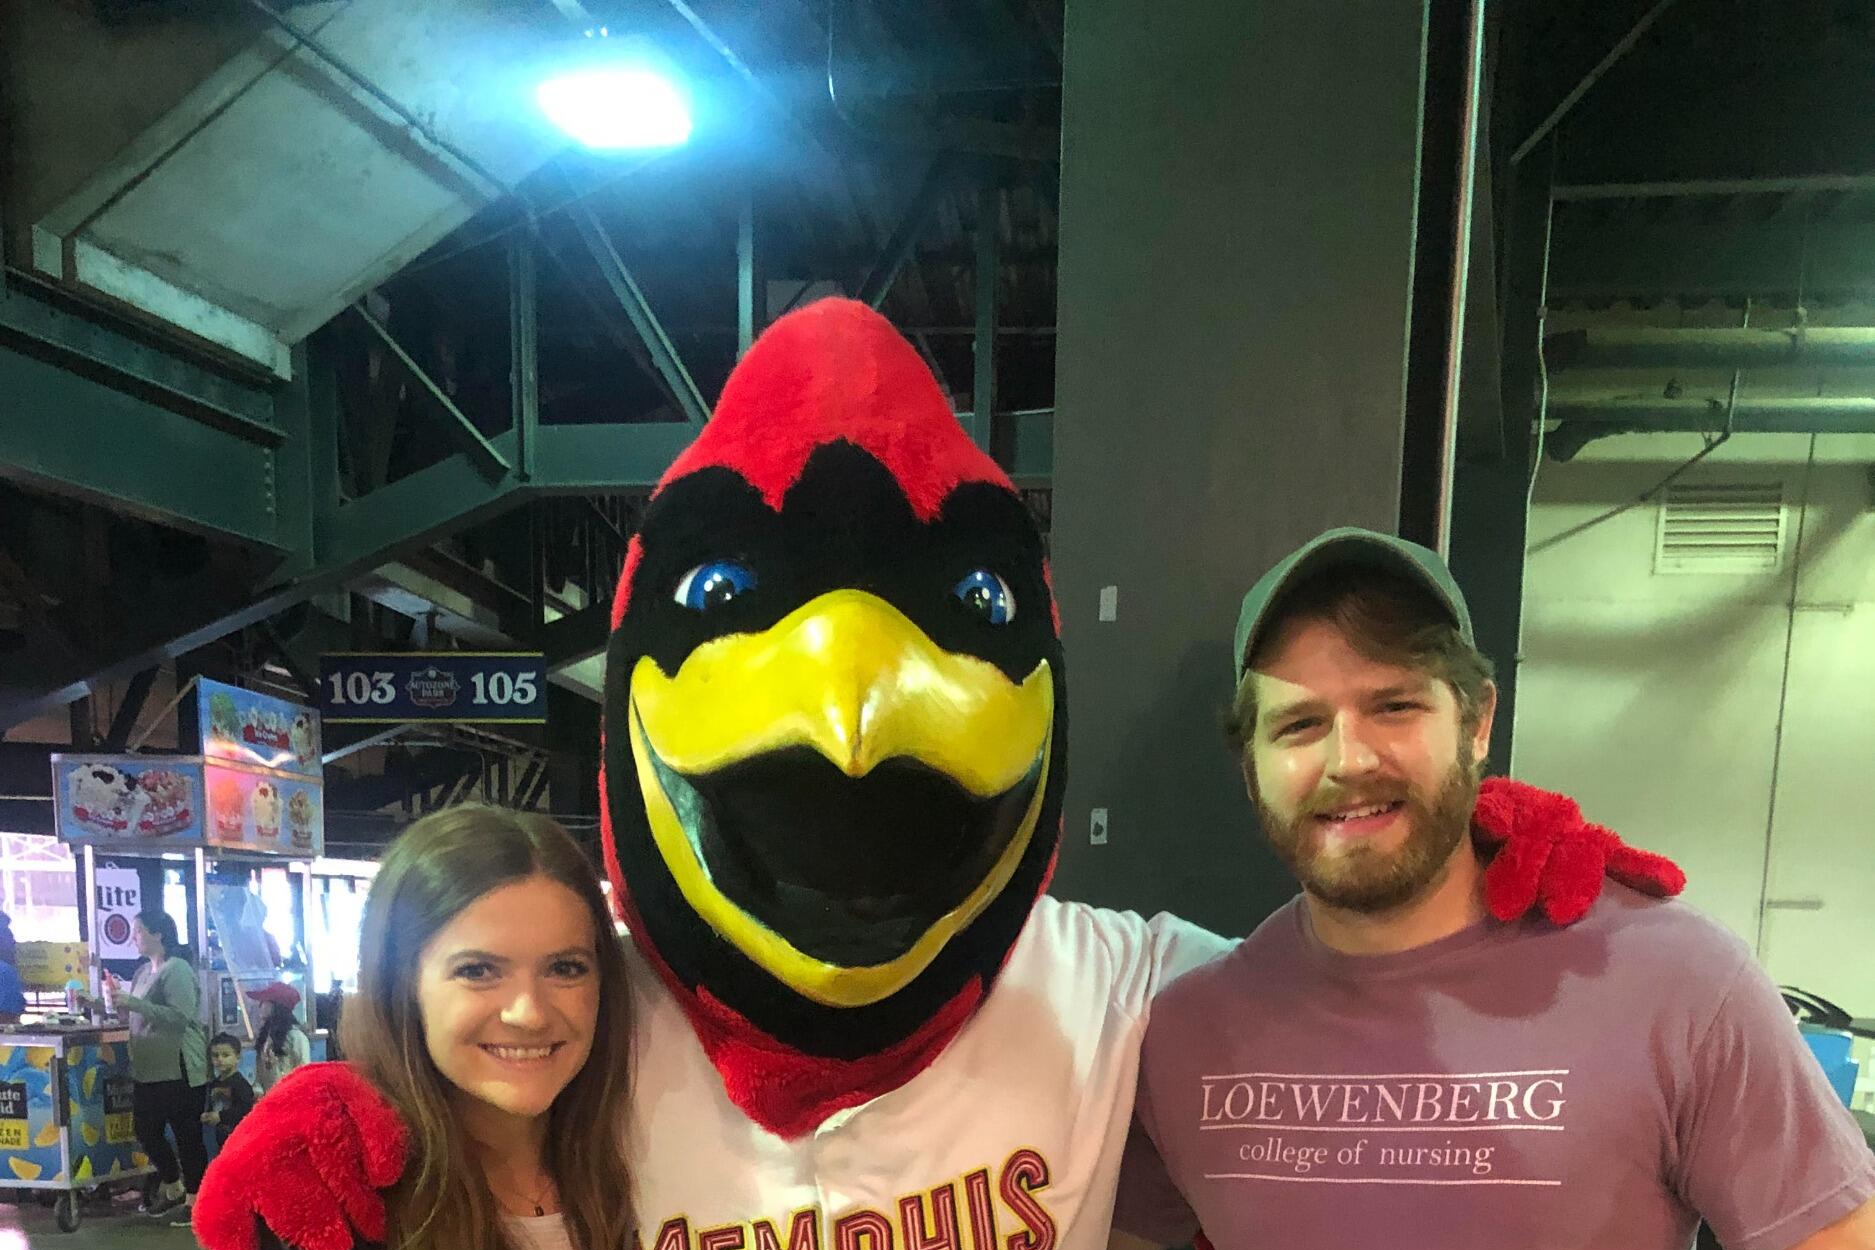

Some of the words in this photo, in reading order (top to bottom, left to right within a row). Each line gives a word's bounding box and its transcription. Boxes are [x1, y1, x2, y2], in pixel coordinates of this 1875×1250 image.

[328, 670, 397, 705] 103
[470, 670, 538, 705] 105
[96, 885, 137, 912] Lite
[1200, 1078, 1567, 1124] LOEWENBERG
[1239, 1137, 1328, 1173] college
[1336, 1138, 1368, 1165] of
[1380, 1139, 1496, 1175] nursing
